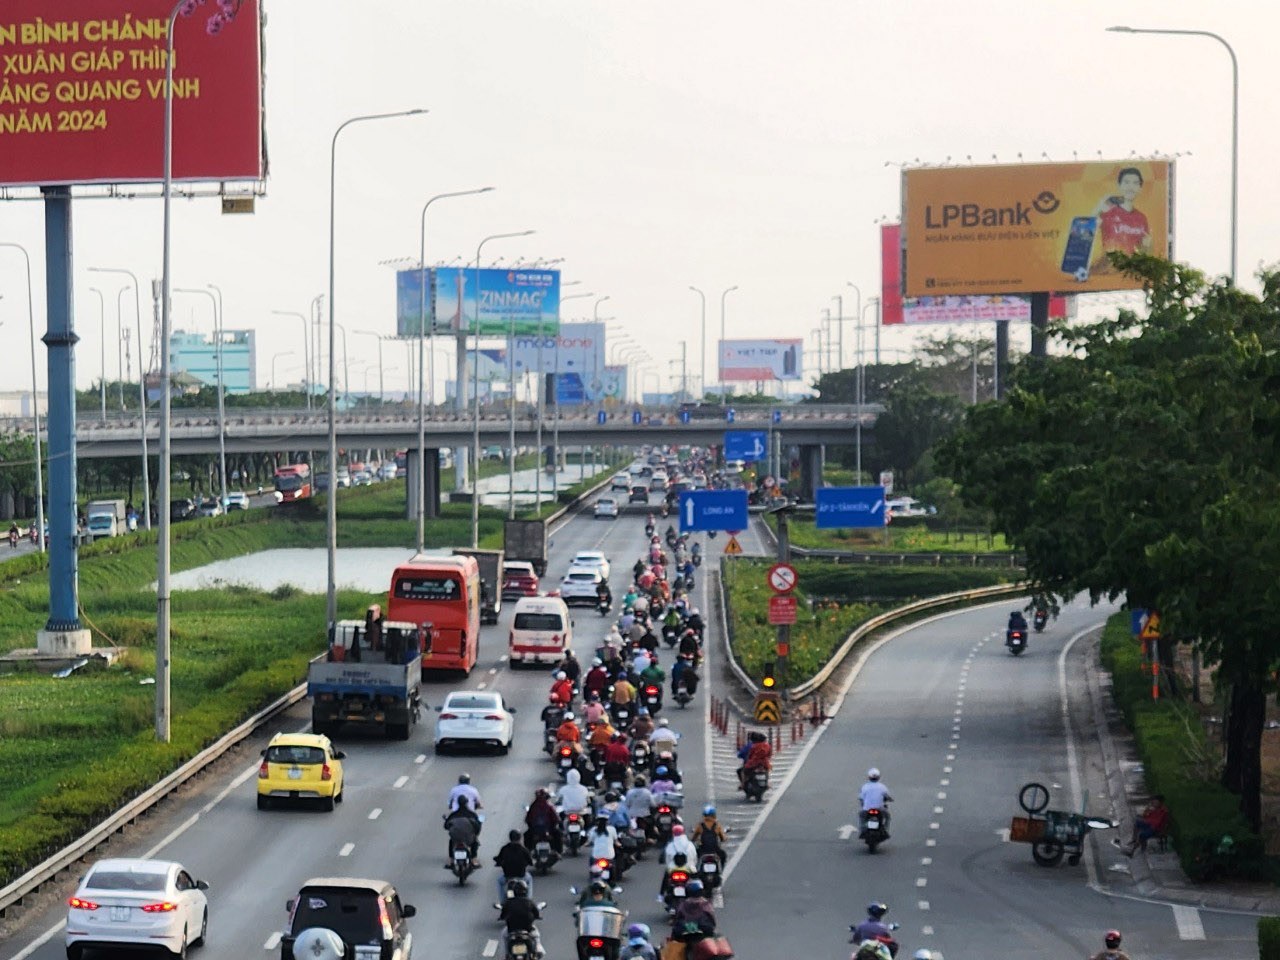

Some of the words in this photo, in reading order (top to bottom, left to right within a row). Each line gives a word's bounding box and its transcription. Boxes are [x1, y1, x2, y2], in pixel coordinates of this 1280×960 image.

[21, 16, 79, 45] BÌNH
[83, 13, 171, 43] CHÁNH
[3, 48, 65, 75] XUÂN
[71, 45, 124, 73] GIÁP
[128, 44, 177, 71] THÌN
[55, 78, 142, 104] QUANG
[146, 76, 200, 100] VINH
[57, 108, 107, 132] 2024
[925, 202, 1032, 229] LPBank
[480, 289, 542, 307] ZINMAG
[703, 506, 725, 515] LONG
[726, 506, 735, 515] AN
